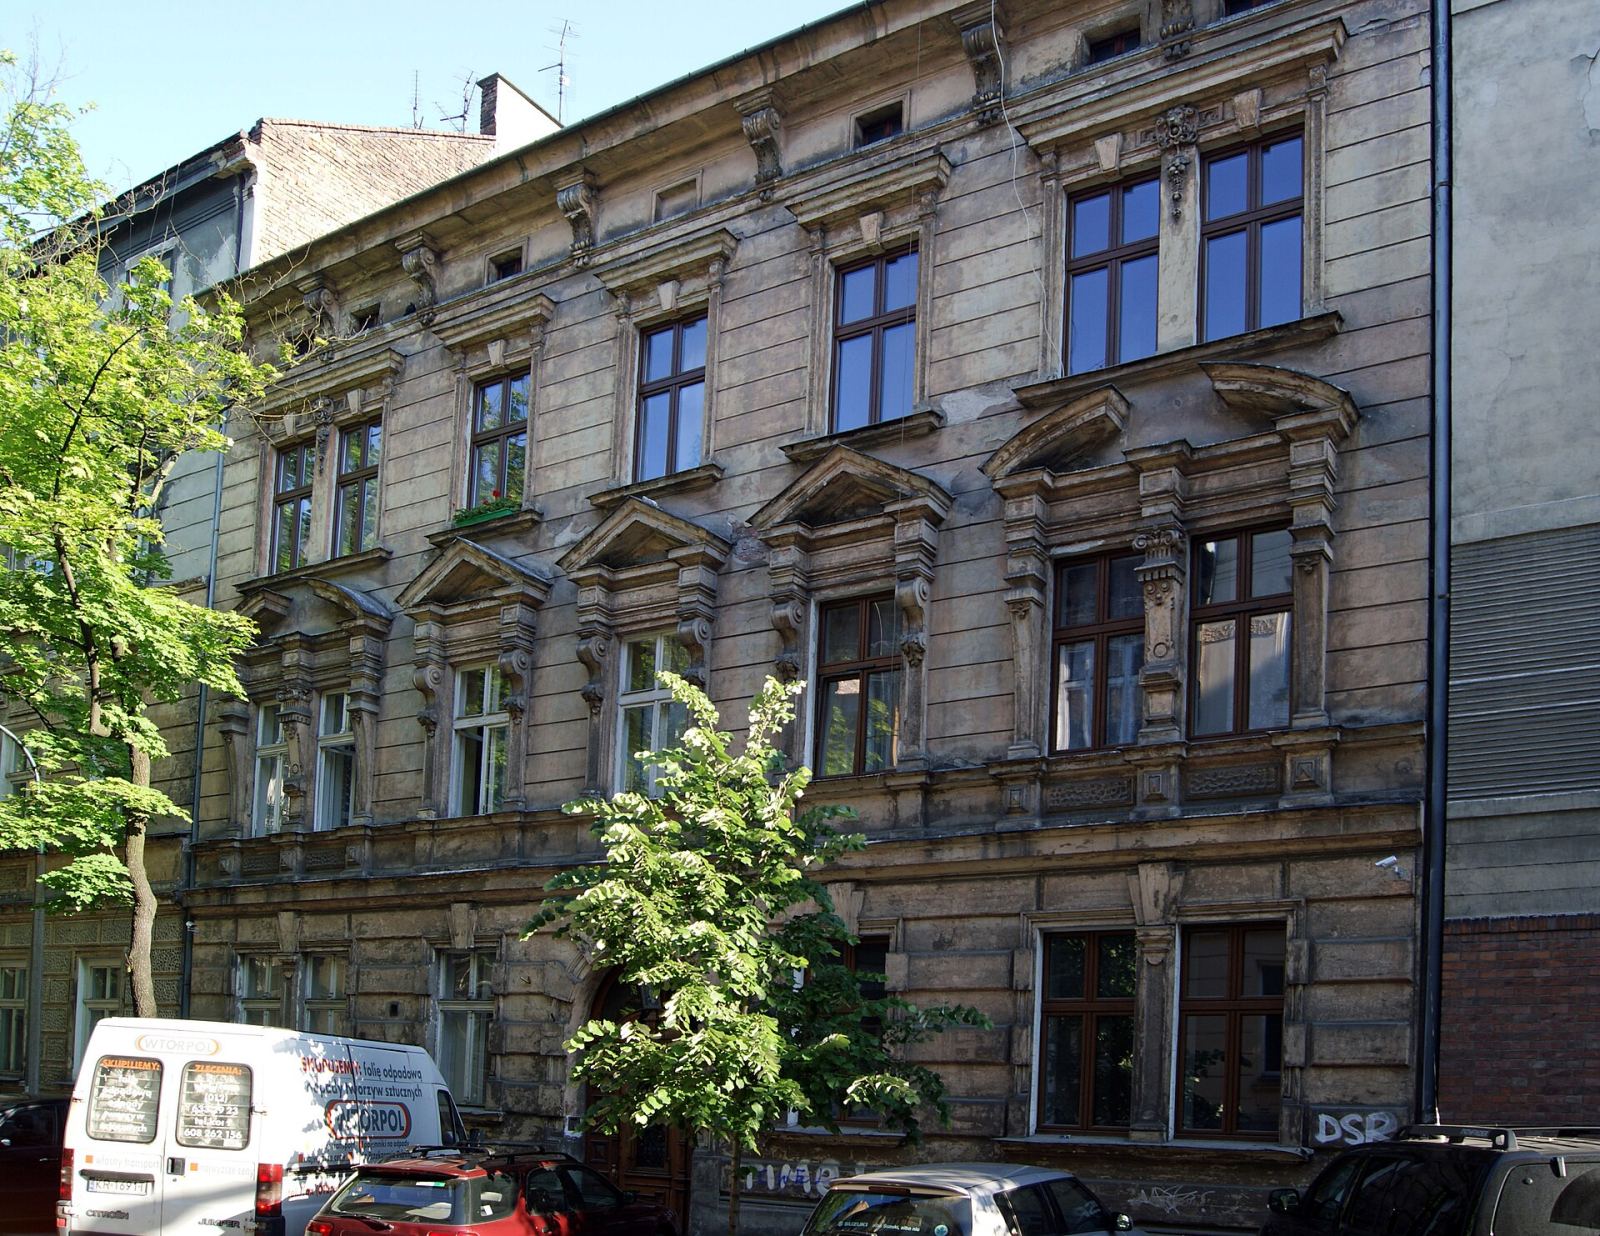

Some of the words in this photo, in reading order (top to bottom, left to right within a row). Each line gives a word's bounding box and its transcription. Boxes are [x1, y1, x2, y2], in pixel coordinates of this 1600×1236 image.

[145, 1039, 212, 1052] WTORPOL
[363, 1061, 381, 1081] folię
[383, 1064, 422, 1083] odpadową
[204, 1093, 228, 1104] (012)
[385, 1083, 423, 1102] sztucznych
[183, 1128, 202, 1137] 608
[204, 1129, 222, 1138] 262
[225, 1130, 242, 1139] 156
[1315, 1111, 1398, 1145] DSR
[86, 1209, 129, 1220] CITROËN
[197, 1217, 240, 1229] JUMPER
